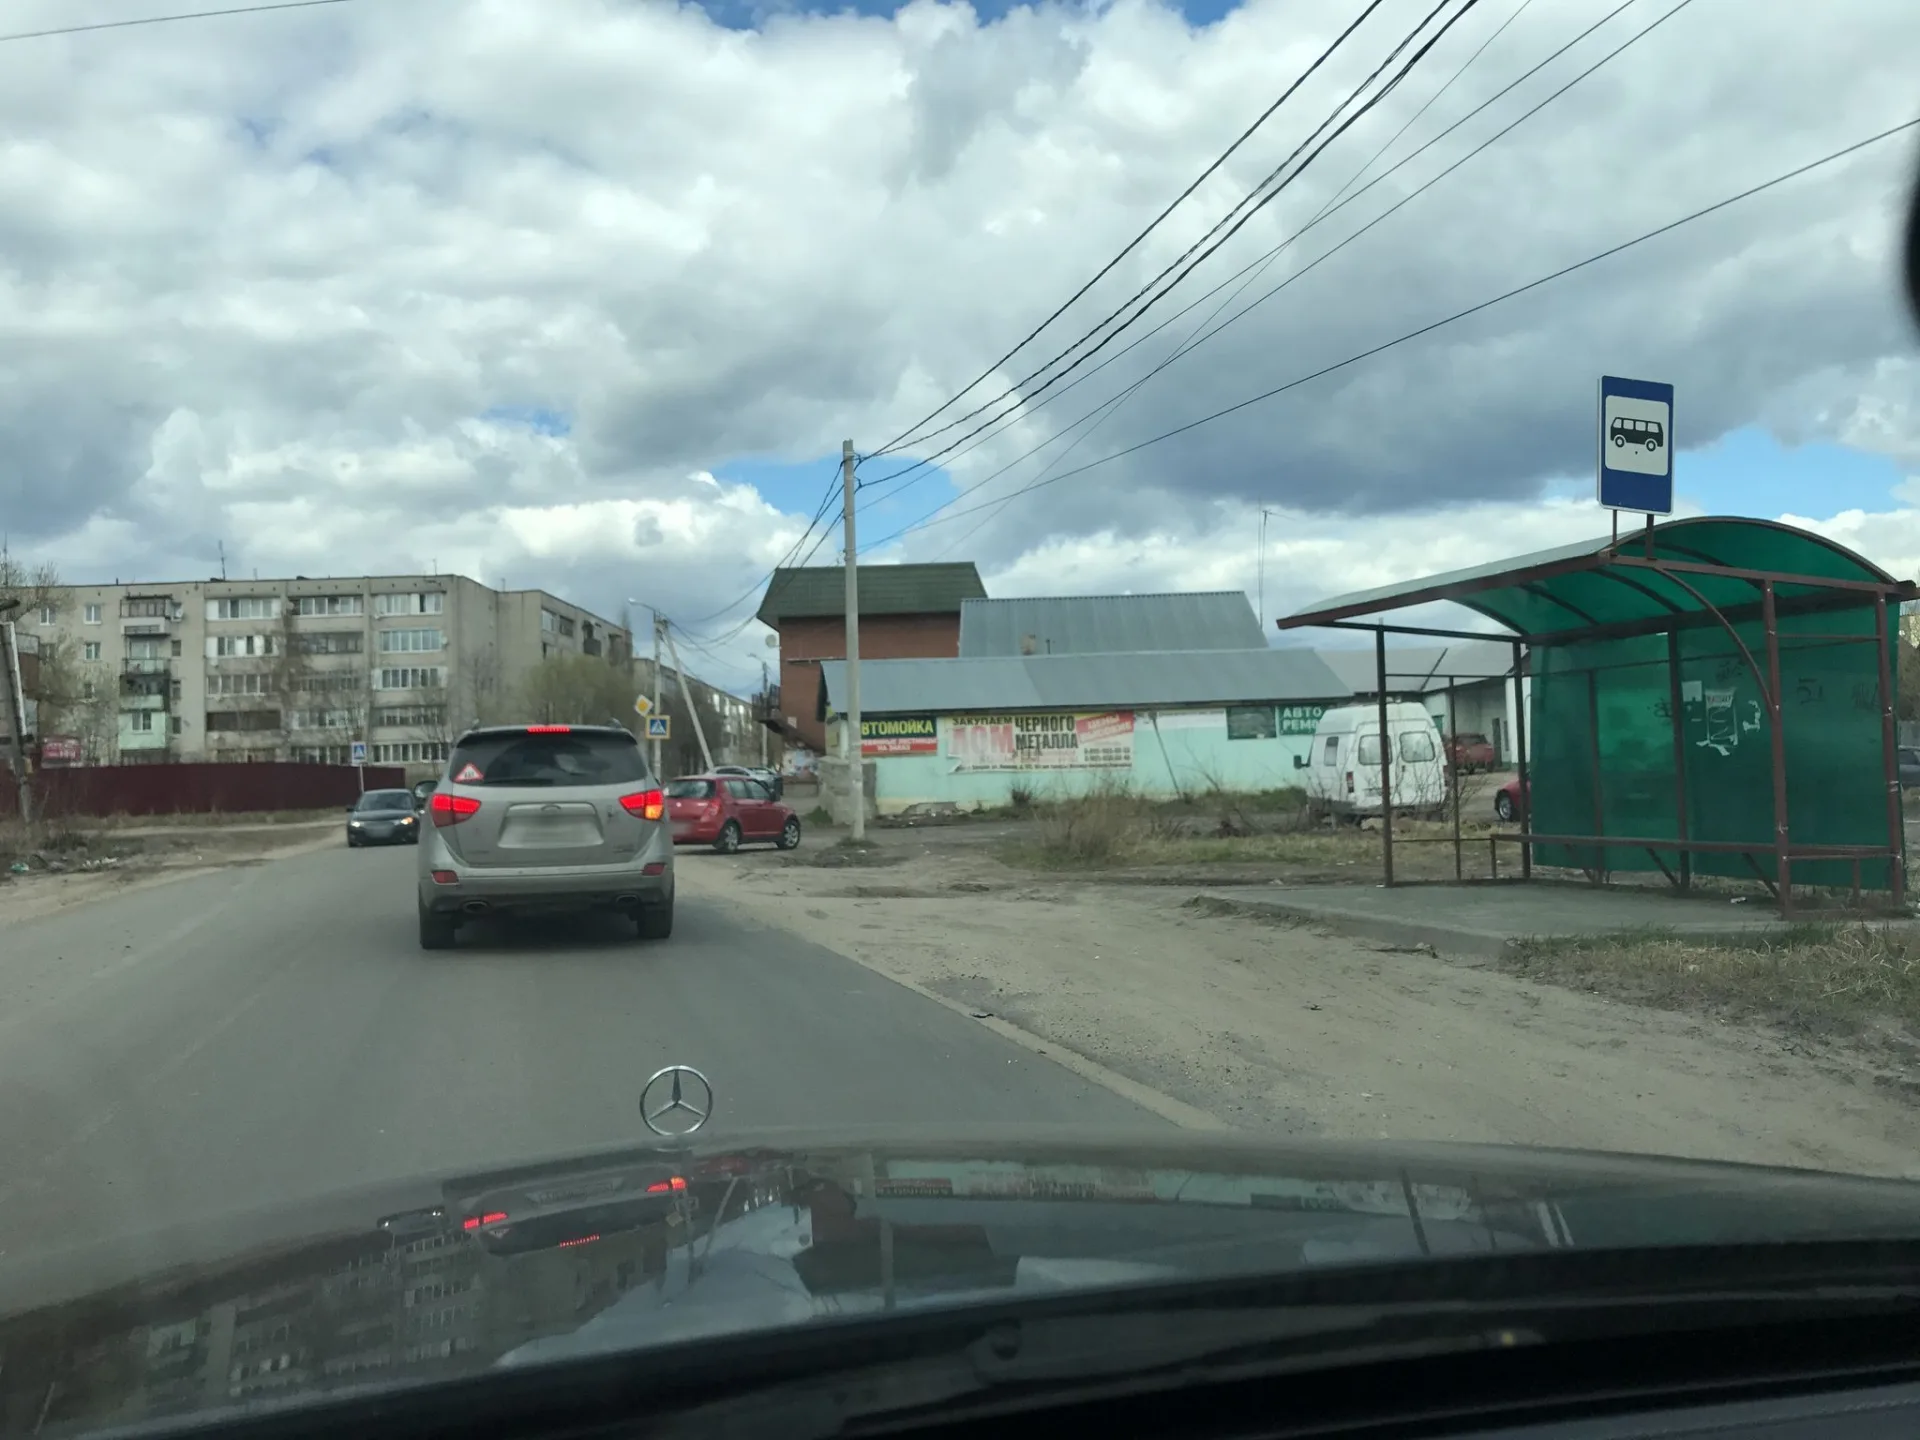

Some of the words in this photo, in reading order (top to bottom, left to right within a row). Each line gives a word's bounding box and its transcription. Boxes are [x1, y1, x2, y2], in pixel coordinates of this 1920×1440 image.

[1283, 706, 1322, 718] АВТО
[861, 719, 934, 736] ВТОМОЙКА
[952, 716, 1012, 726] ЗАКУПАЕМ
[1014, 715, 1075, 732] ЧЕРНОГО
[1283, 719, 1316, 730] РЕМО
[949, 724, 1014, 754] ЛОМ
[1015, 733, 1079, 750] МЕТАЛЛА
